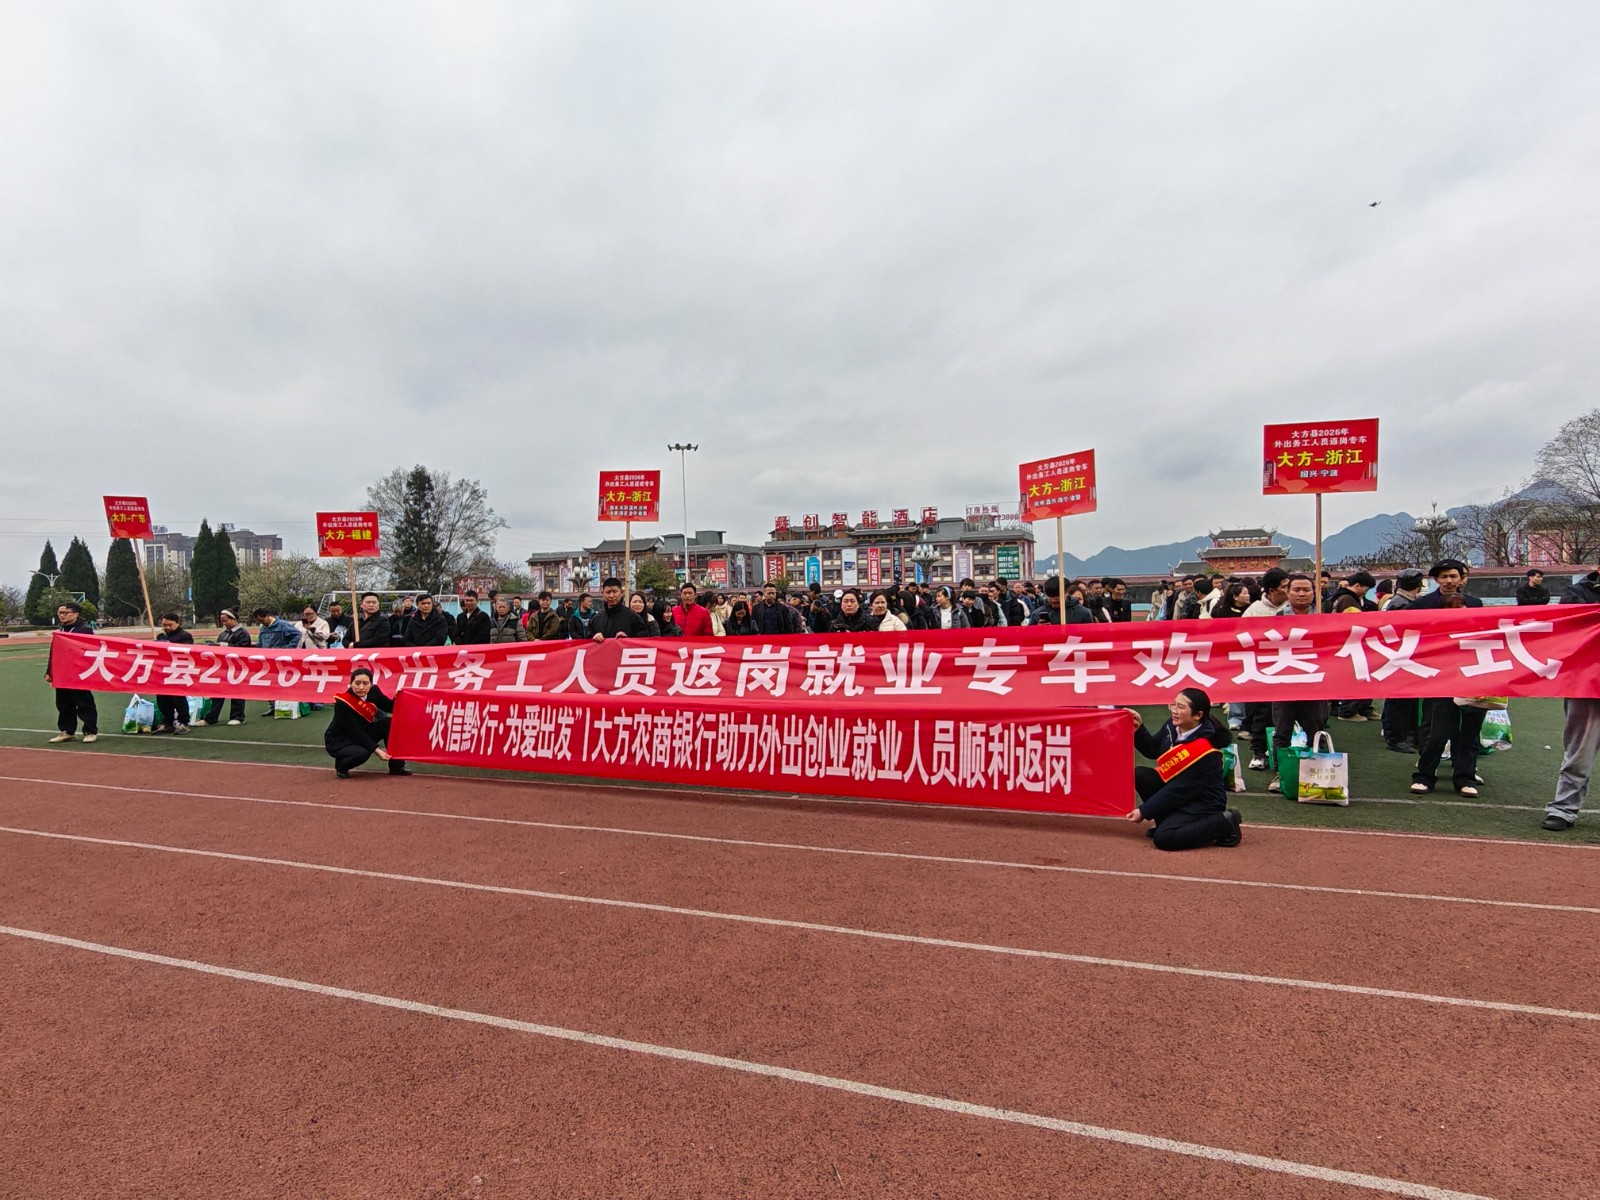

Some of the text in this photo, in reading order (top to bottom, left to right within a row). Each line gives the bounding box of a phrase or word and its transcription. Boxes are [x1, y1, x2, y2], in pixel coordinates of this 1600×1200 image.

[1292, 428, 1349, 439] 大方县2026年
[1274, 435, 1367, 448] 外出务工人员返岗专车
